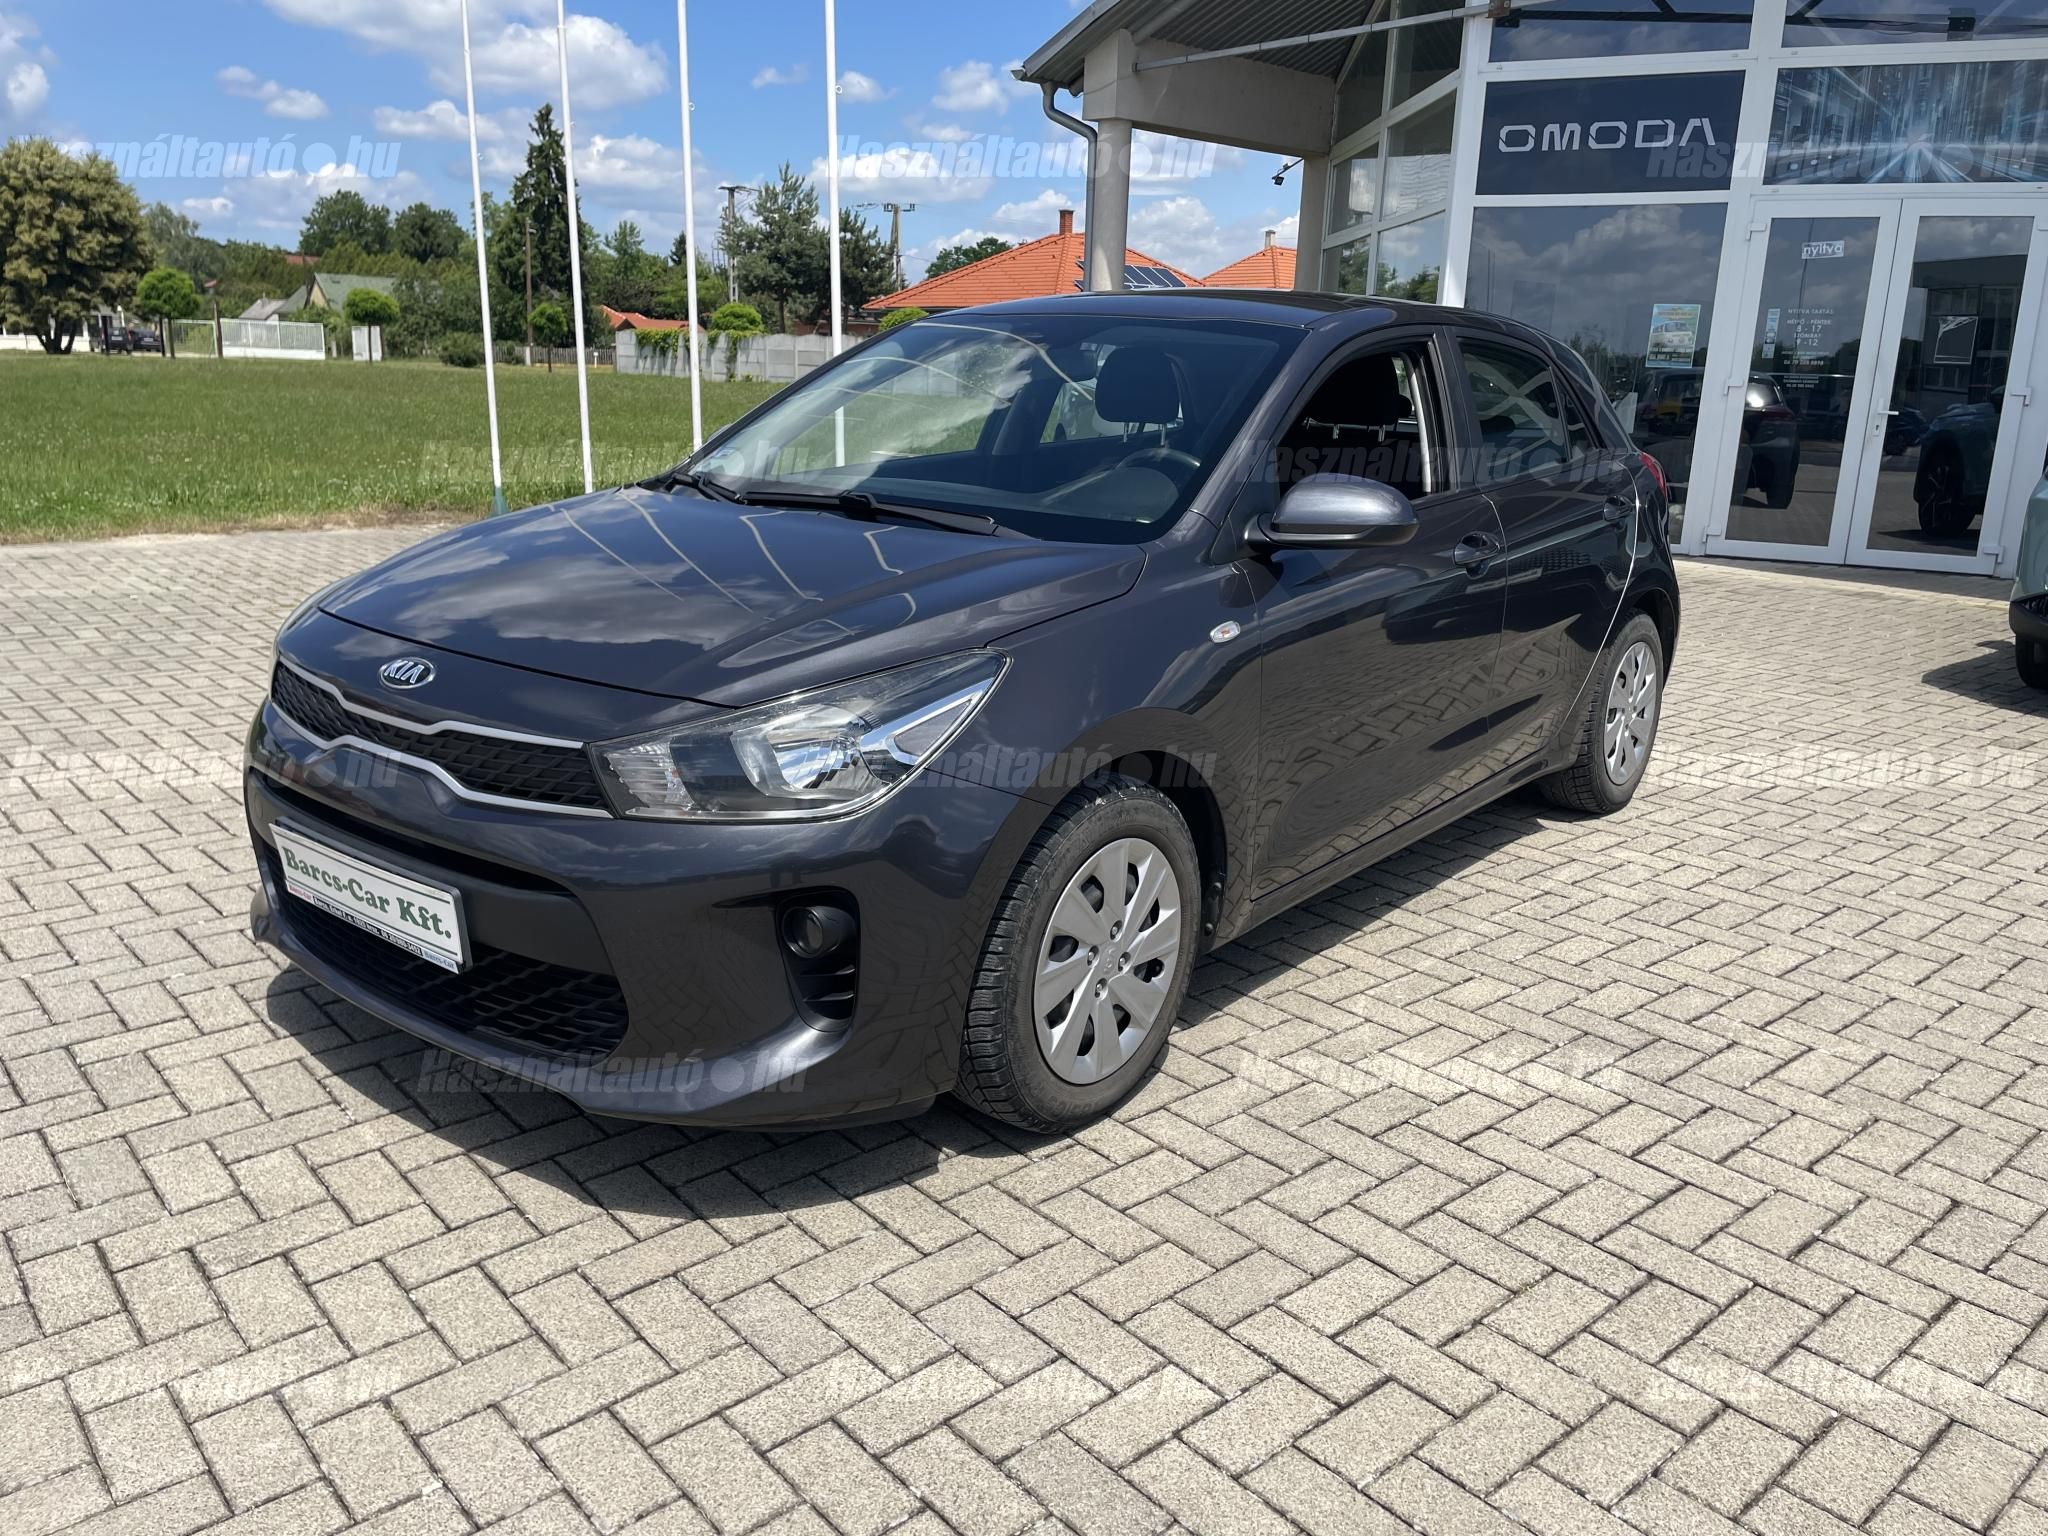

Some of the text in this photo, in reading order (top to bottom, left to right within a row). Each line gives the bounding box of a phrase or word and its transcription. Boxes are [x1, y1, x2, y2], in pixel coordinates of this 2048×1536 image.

[1499, 118, 1716, 152] OMODA
[384, 660, 425, 684] KIA
[282, 846, 452, 939] Barcs-Car Kft.
